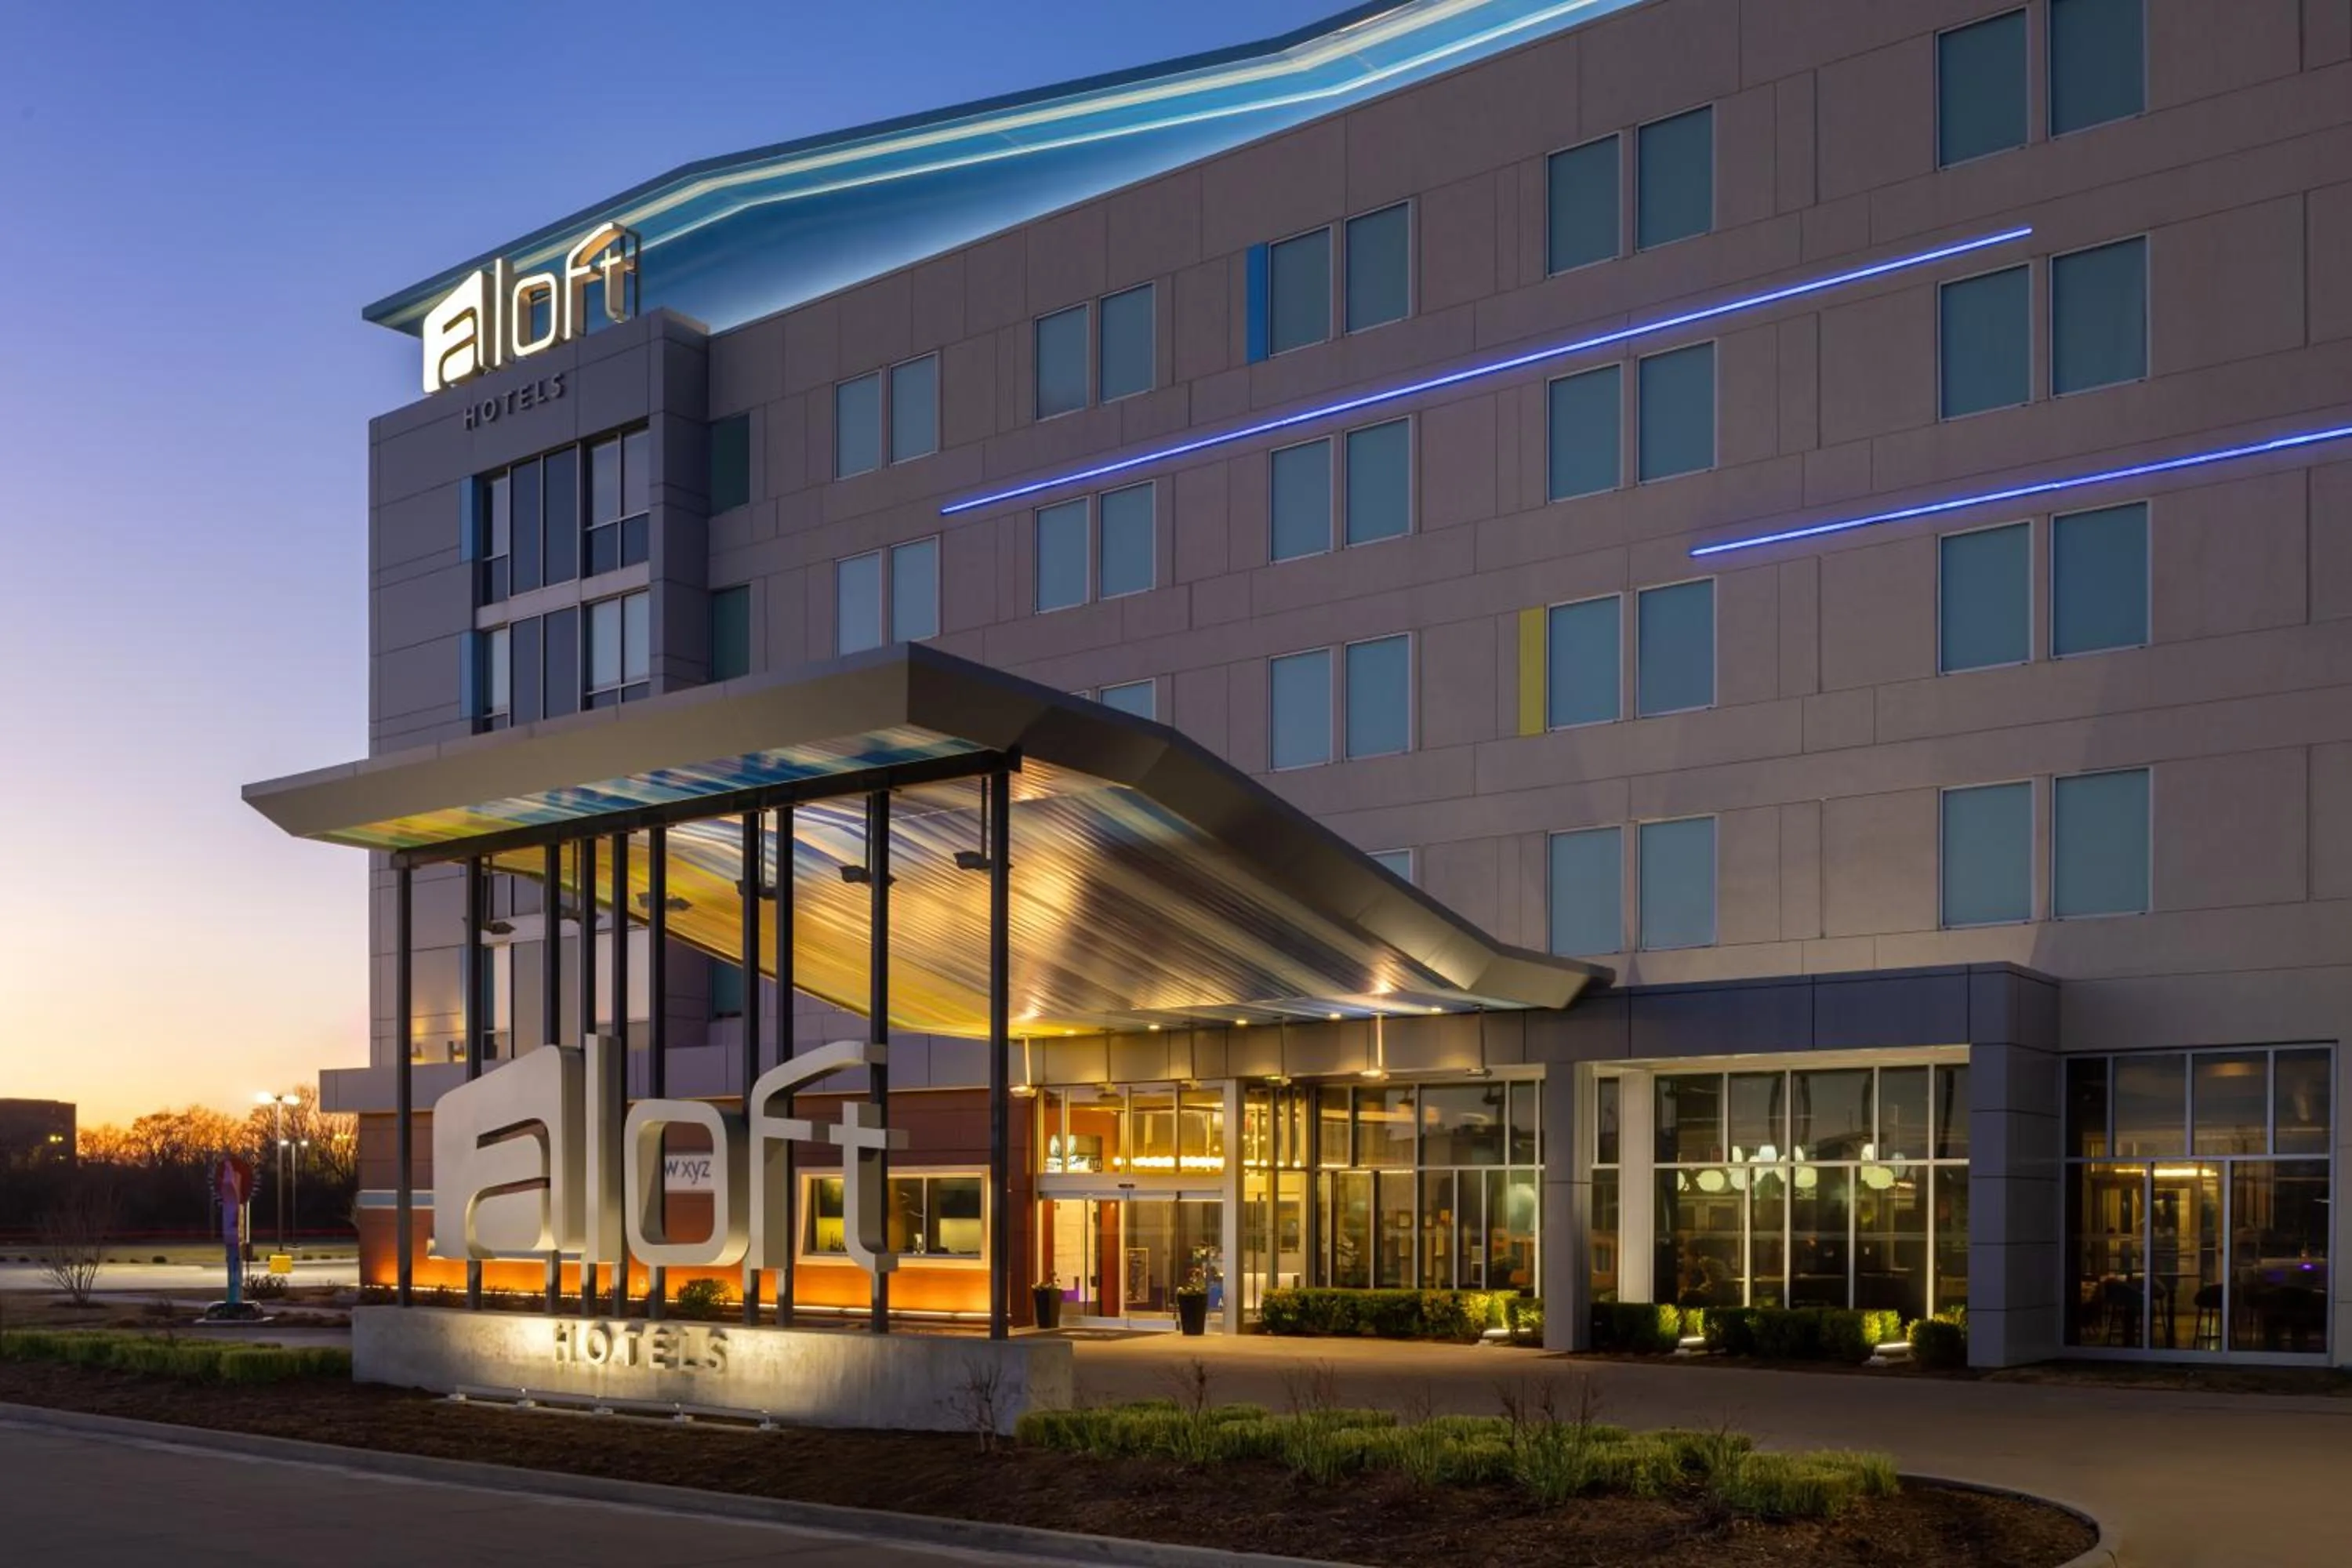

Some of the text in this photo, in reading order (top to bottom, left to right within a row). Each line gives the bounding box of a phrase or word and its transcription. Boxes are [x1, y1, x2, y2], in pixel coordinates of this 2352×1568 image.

[423, 221, 628, 393] aloft
[463, 373, 564, 430] HOTELS
[433, 1033, 887, 1272] aloft
[554, 1323, 728, 1373] HOTELS
